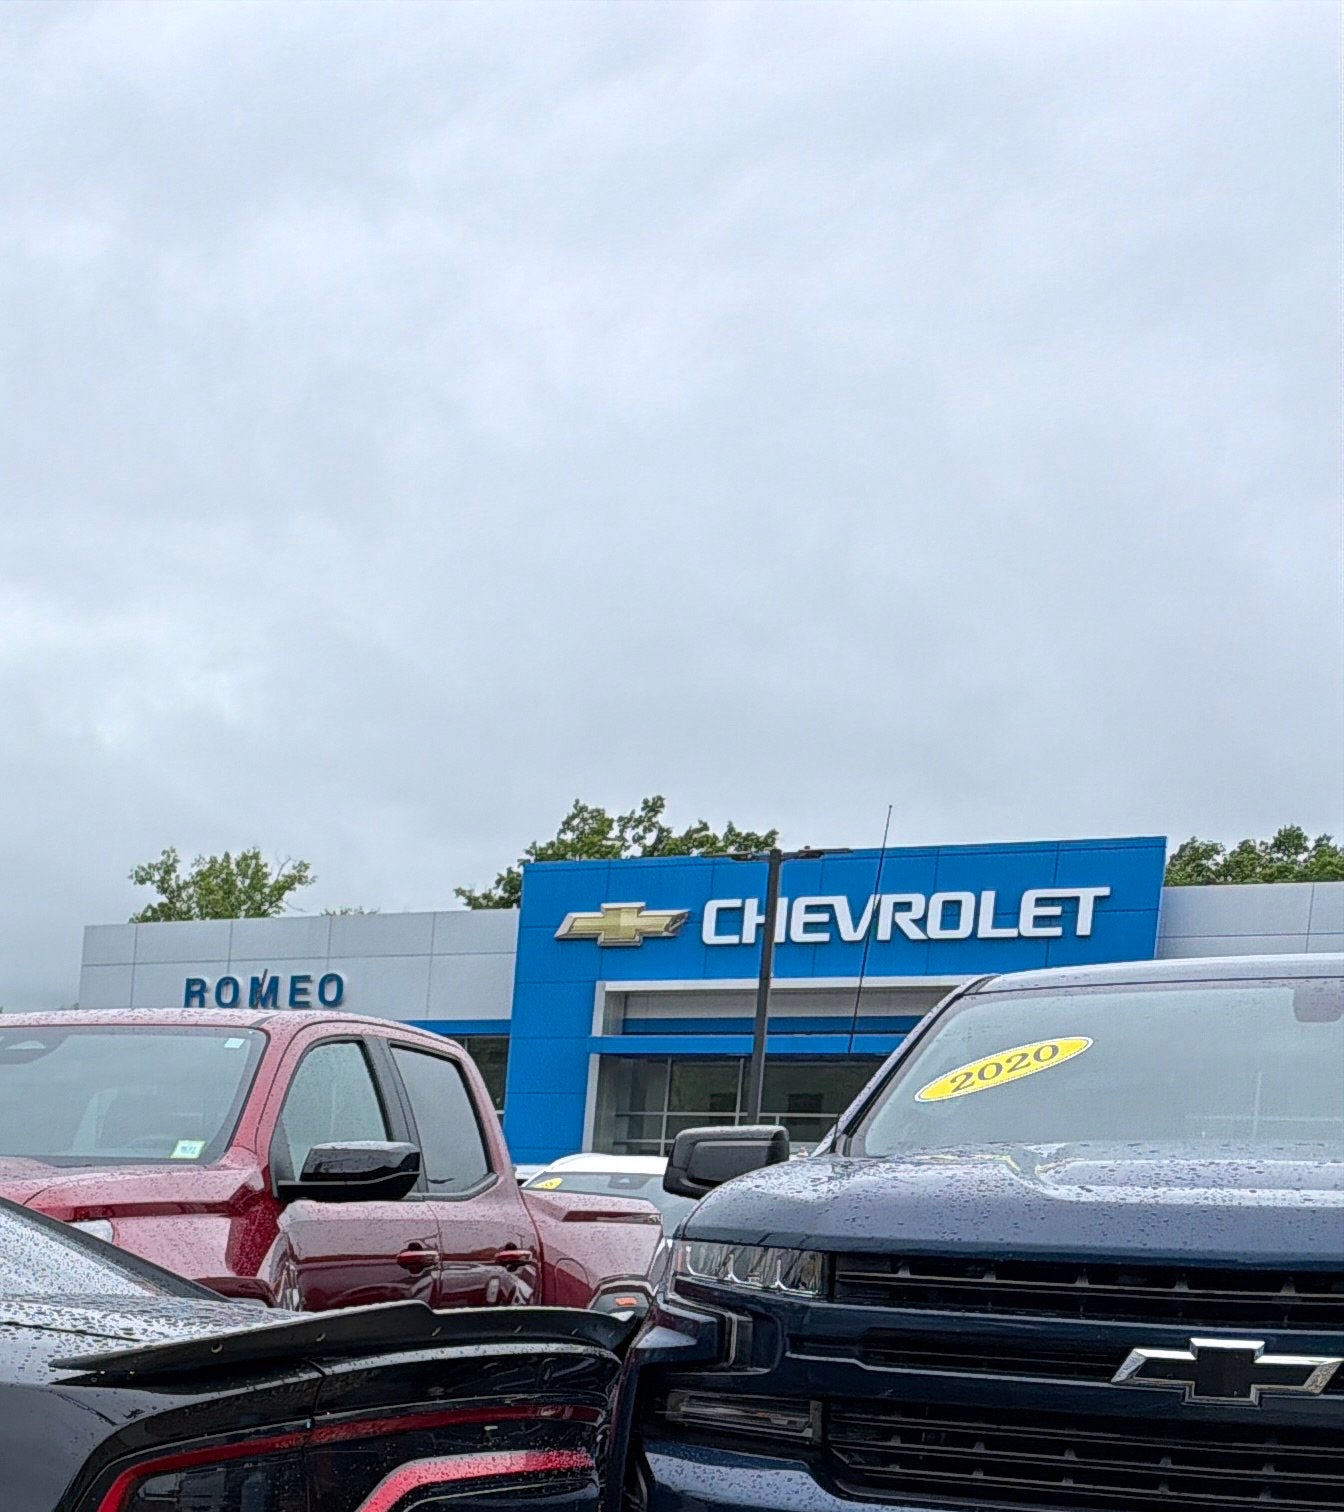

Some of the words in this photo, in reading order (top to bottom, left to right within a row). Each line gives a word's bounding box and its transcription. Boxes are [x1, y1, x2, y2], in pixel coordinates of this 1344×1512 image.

[702, 886, 1111, 945] CHEVROLET
[183, 972, 345, 1010] ROMEO
[949, 1044, 1060, 1093] 2020
